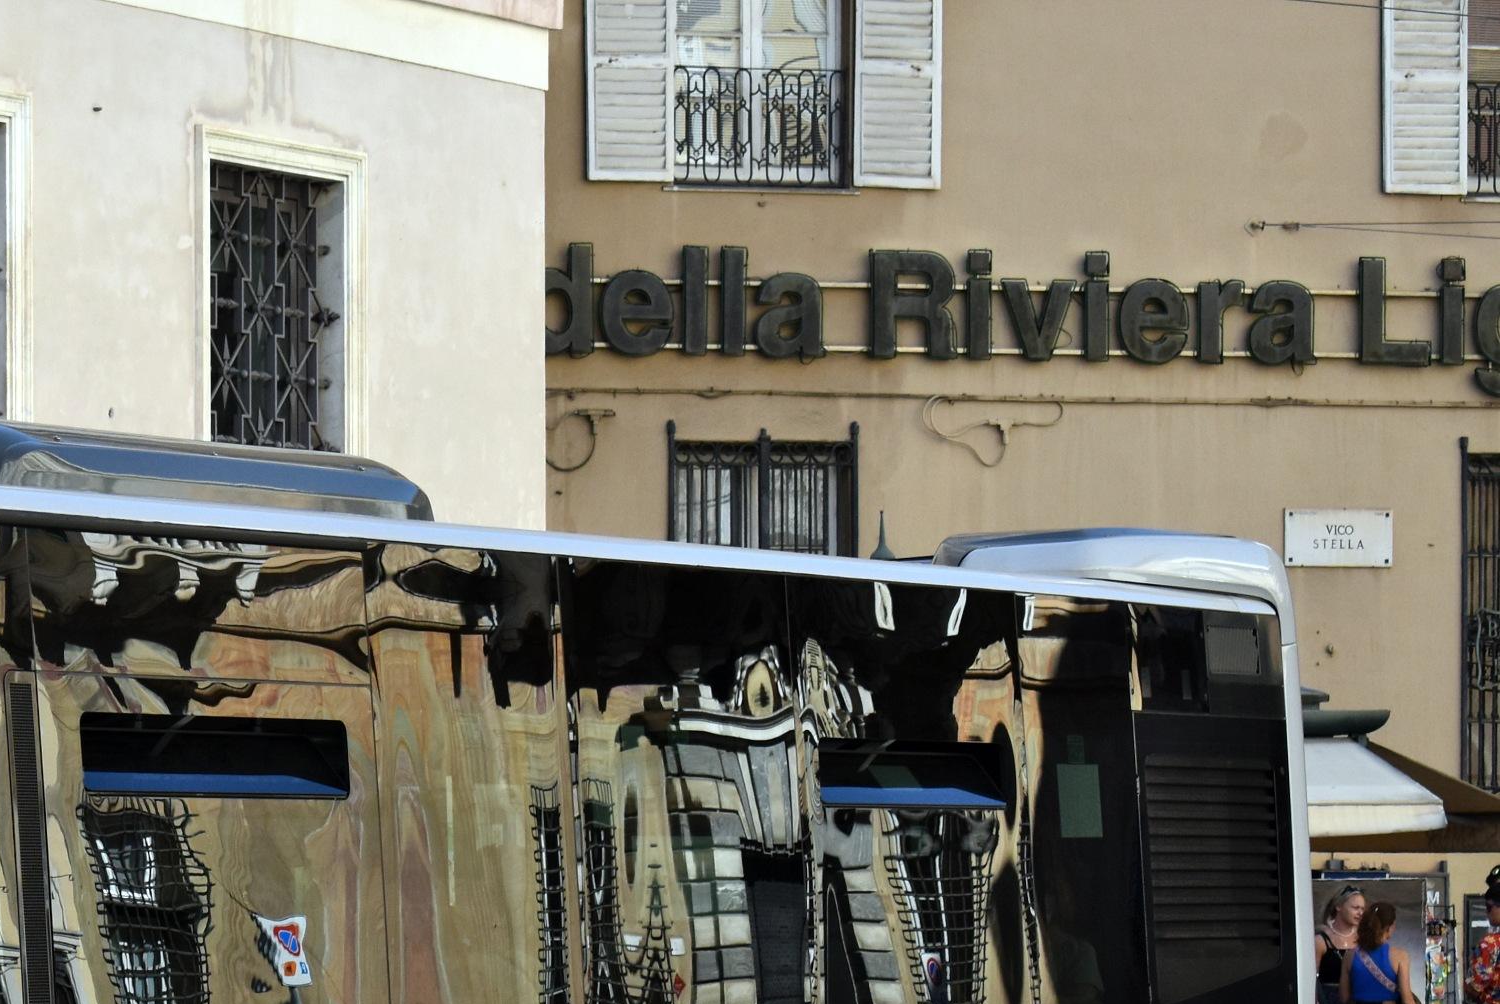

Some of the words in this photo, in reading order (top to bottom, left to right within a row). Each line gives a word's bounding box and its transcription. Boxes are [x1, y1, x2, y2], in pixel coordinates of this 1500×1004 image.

[545, 242, 825, 358] della
[868, 248, 1317, 366] Riviera
[1325, 524, 1355, 536] VICO
[1312, 538, 1365, 550] STELLA
